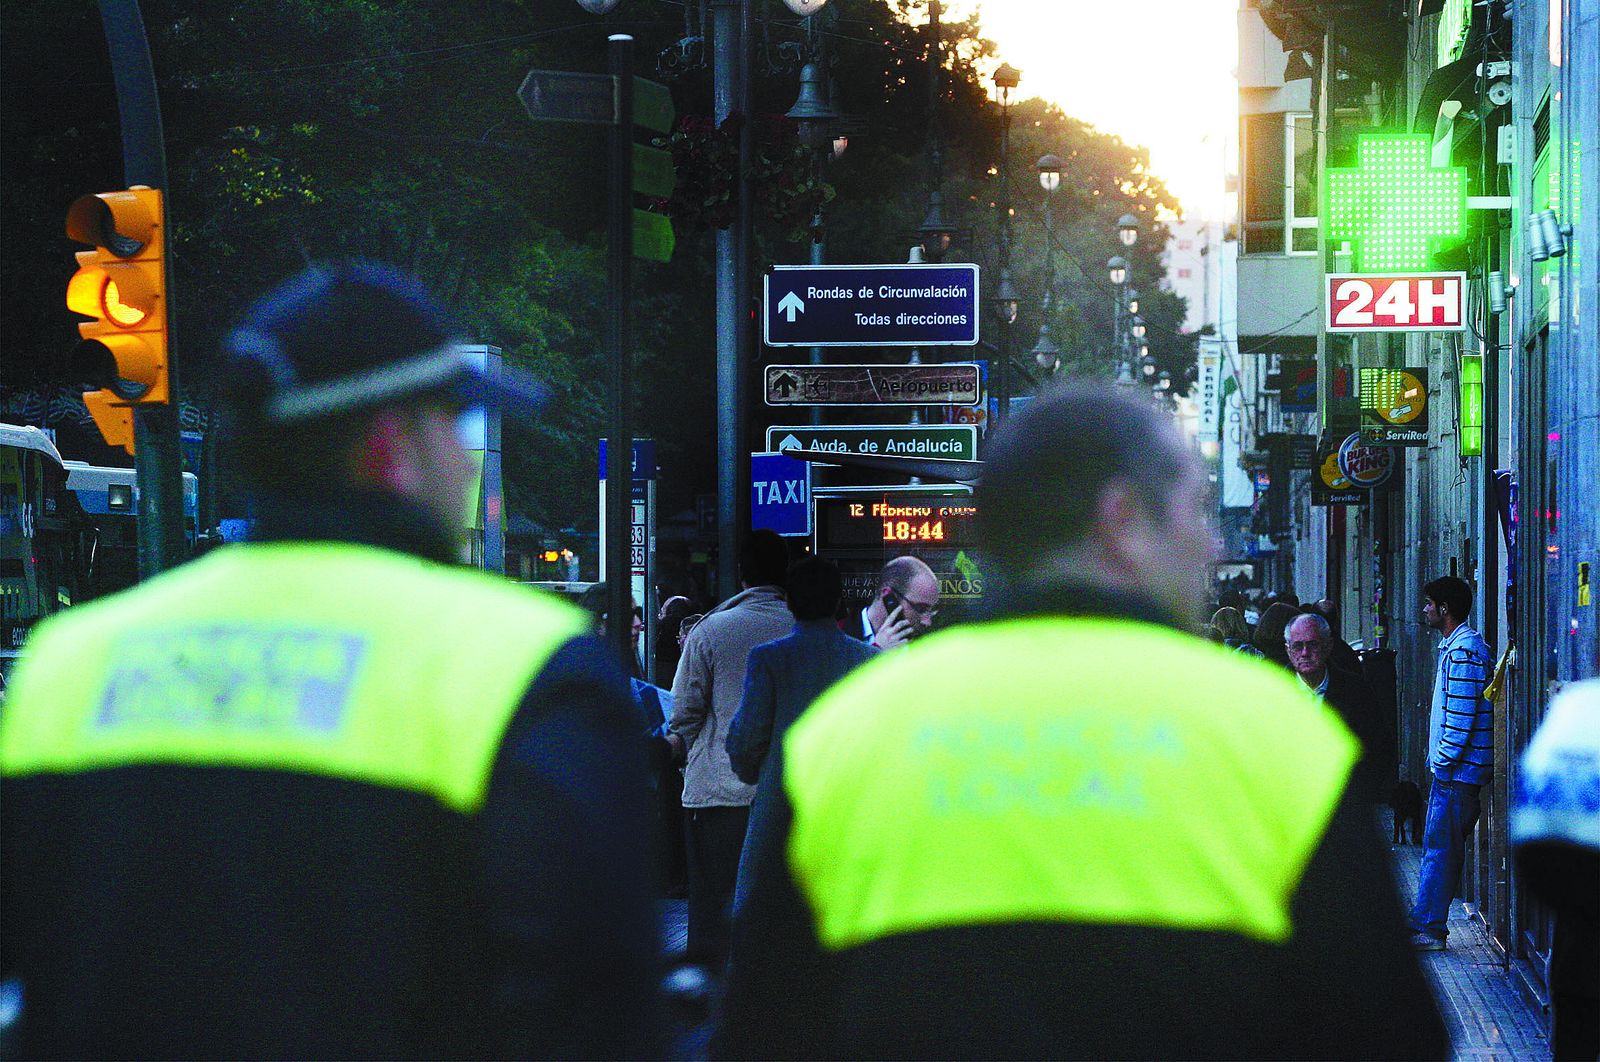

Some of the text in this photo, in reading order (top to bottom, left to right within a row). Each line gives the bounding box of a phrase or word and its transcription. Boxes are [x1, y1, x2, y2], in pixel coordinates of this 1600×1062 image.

[807, 284, 967, 299] Rondas de Circunvalación
[1334, 280, 1459, 325] 24H
[855, 312, 967, 326] Todas direcciones
[880, 379, 973, 395] Aeropuerto
[1385, 430, 1428, 442] ServiRed
[810, 438, 963, 453] Avda. de Andalucía
[753, 479, 805, 505] TAXI
[1330, 494, 1361, 502] ServiRed
[849, 504, 865, 517] 12
[883, 521, 944, 540] 18:44
